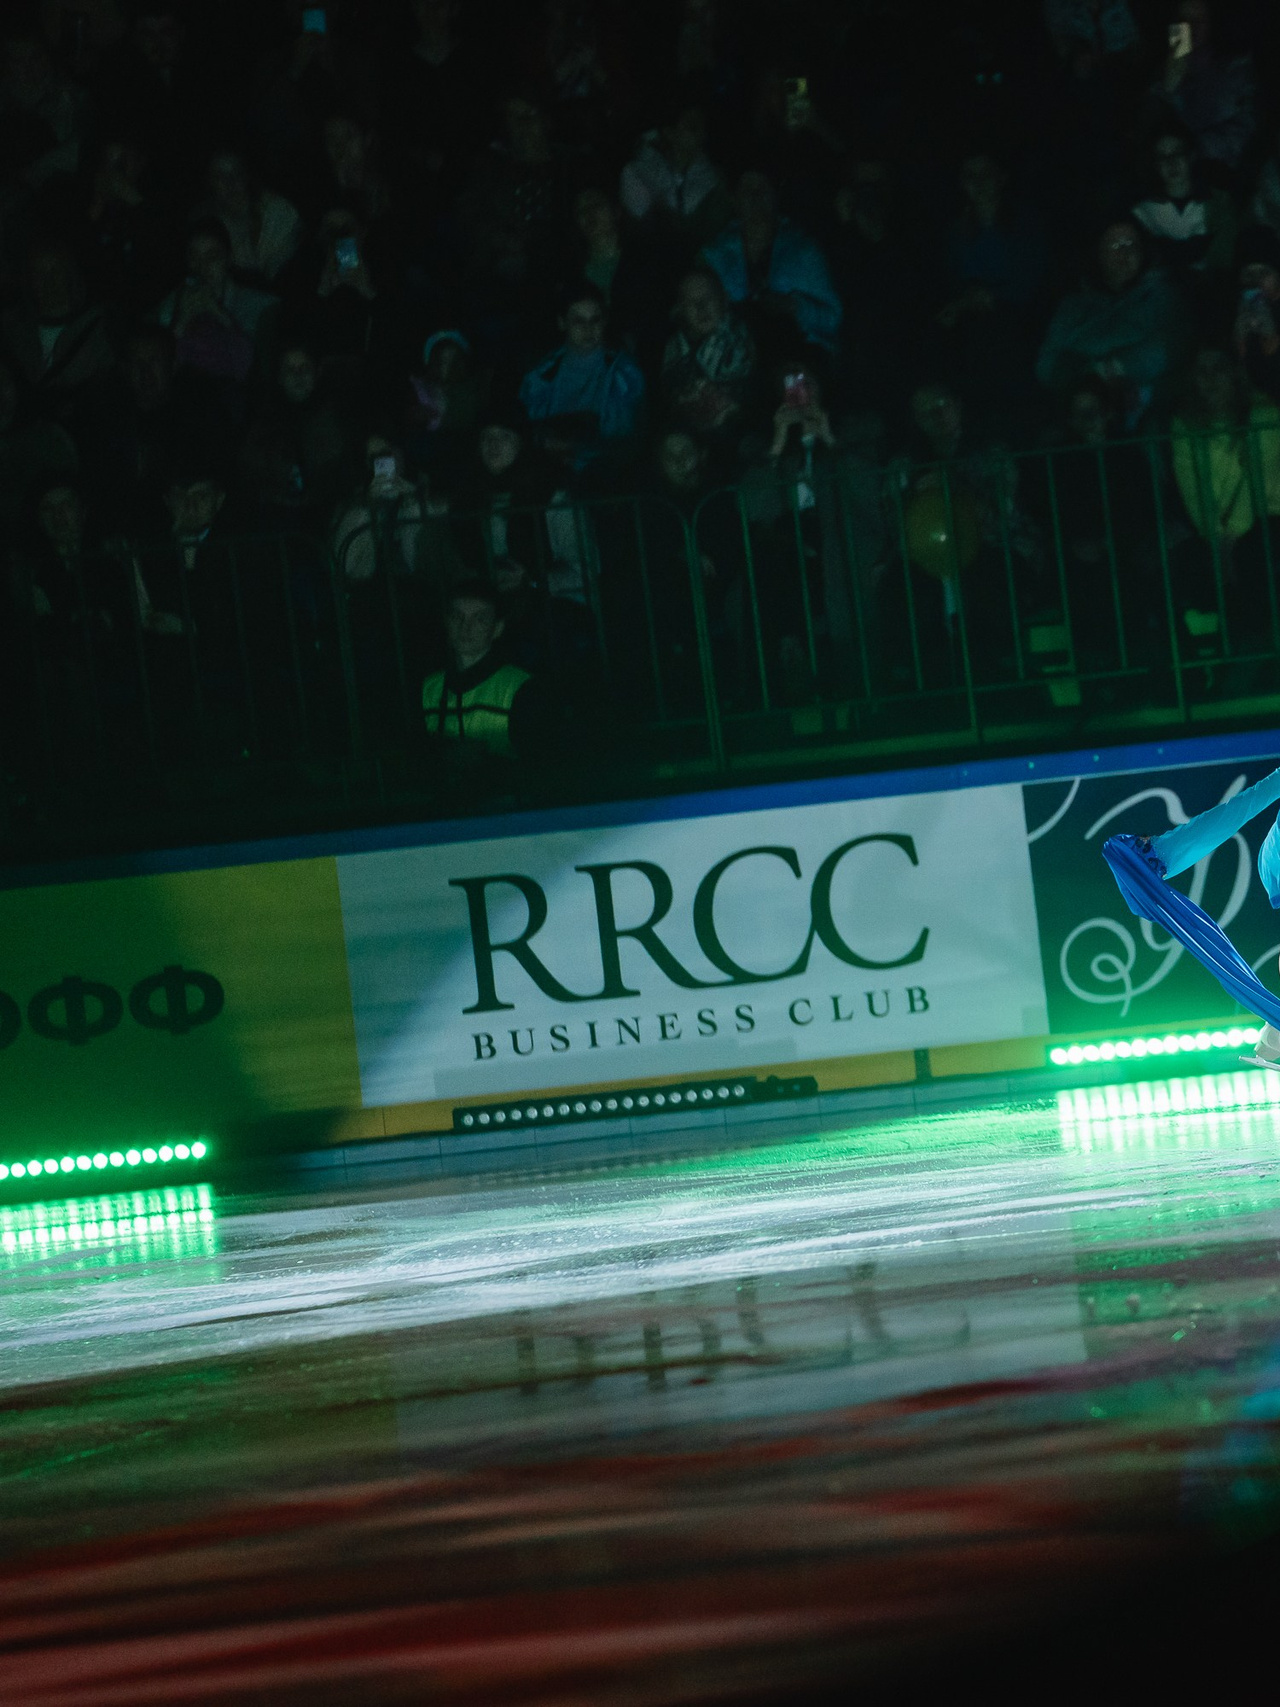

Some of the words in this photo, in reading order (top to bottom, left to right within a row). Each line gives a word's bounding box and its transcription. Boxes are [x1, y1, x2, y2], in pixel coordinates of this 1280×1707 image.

[448, 833, 930, 1014] RRCC
[473, 1004, 757, 1062] BUSINESS
[788, 985, 931, 1027] CLUB
